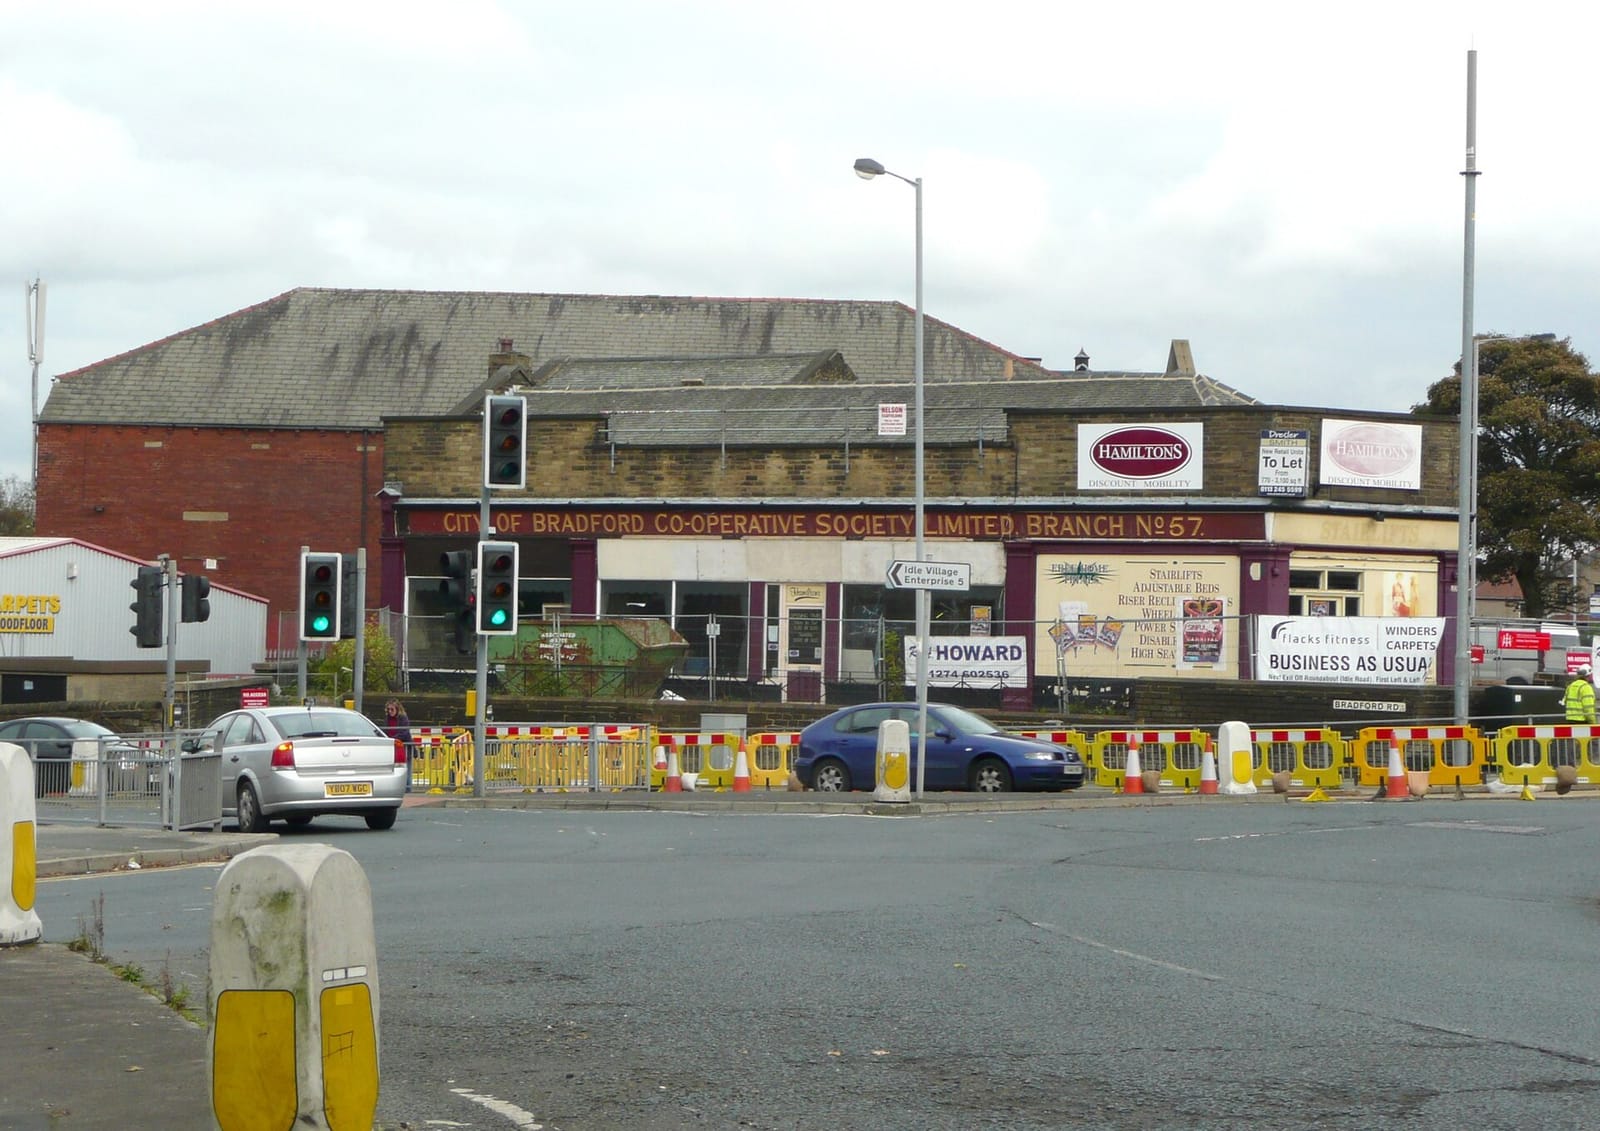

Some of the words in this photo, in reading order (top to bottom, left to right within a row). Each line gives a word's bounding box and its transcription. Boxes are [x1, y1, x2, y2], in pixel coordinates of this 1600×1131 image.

[1098, 444, 1183, 459] HAMILTONS
[1336, 440, 1408, 461] HAMILTONS
[1262, 456, 1277, 468] To
[1282, 457, 1303, 469] Let
[1089, 480, 1136, 488] DISCOUNT
[1144, 480, 1192, 488] MOBILITY
[1328, 476, 1371, 486] DISCOUNT
[1373, 478, 1413, 488] MOBILITY
[444, 512, 482, 532] CITY
[497, 513, 522, 532] OF
[533, 513, 644, 533] BRADFORD
[655, 513, 806, 534] CO-OPERATIVE
[816, 514, 914, 535] SOCIETY
[1027, 515, 1124, 536] BRANCH
[904, 566, 923, 575] Idle
[925, 567, 959, 577] Village
[1150, 568, 1203, 580] STAIRLIFTS
[904, 576, 955, 586] Enterprise
[957, 578, 964, 586] 5
[1133, 582, 1192, 593] ADJUSTABLE
[1195, 582, 1220, 593] BEDS
[0, 594, 61, 614] RPETS
[1118, 594, 1145, 606] RISER
[1148, 596, 1176, 607] RECLI
[1142, 608, 1175, 620] WHEEL
[1134, 621, 1166, 632] POWER
[1385, 626, 1437, 636] WINDERS
[1282, 634, 1320, 644] flacks
[1325, 634, 1370, 645] fitness
[1386, 641, 1436, 650] CARPETS
[936, 645, 1023, 661] HOWARD
[1131, 647, 1153, 659] HIGH
[1270, 654, 1350, 671] BUSINESS
[1356, 655, 1377, 671] AS
[929, 670, 958, 678] 1274
[1375, 676, 1391, 684] First
[1335, 701, 1384, 710] BRADFORD
[1387, 703, 1399, 711] RD
